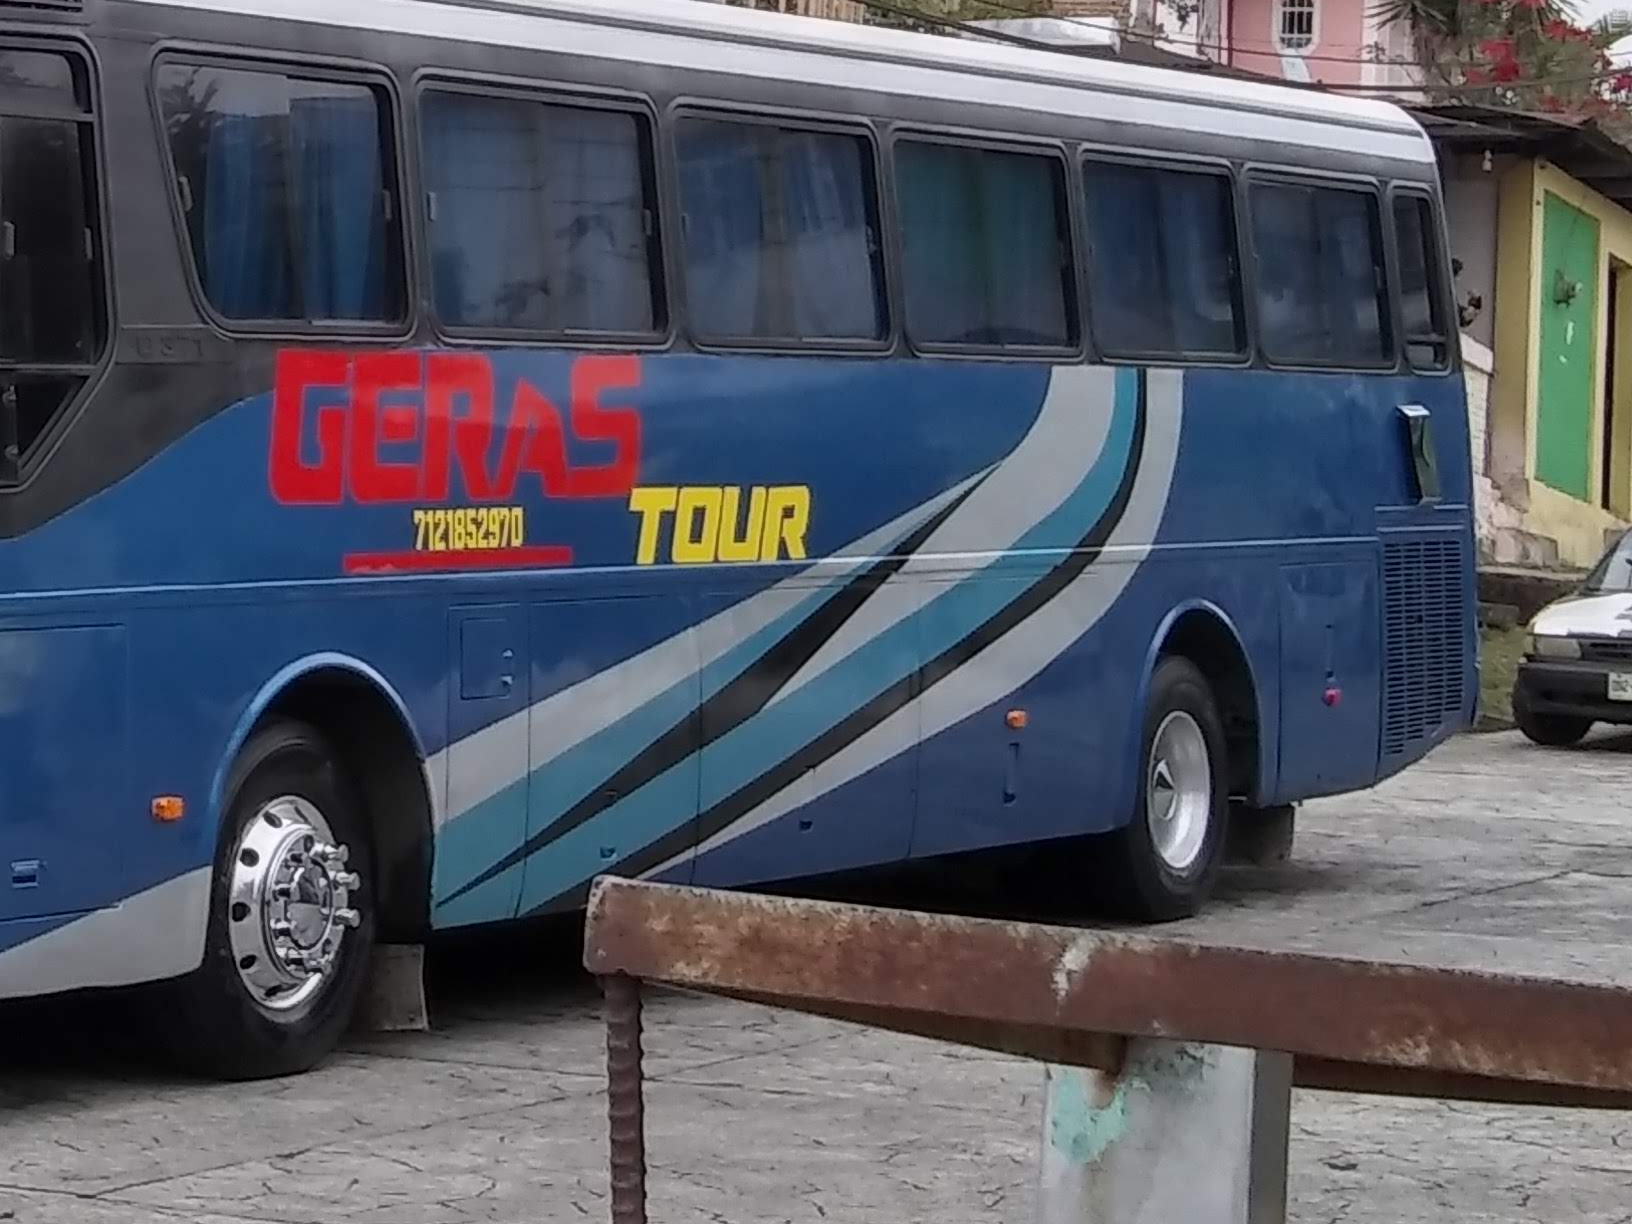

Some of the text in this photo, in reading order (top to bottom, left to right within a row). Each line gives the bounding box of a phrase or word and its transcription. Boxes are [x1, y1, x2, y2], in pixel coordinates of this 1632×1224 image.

[269, 348, 643, 506] GERAS
[412, 506, 525, 551] 7121852970
[628, 484, 812, 564] TOUR
